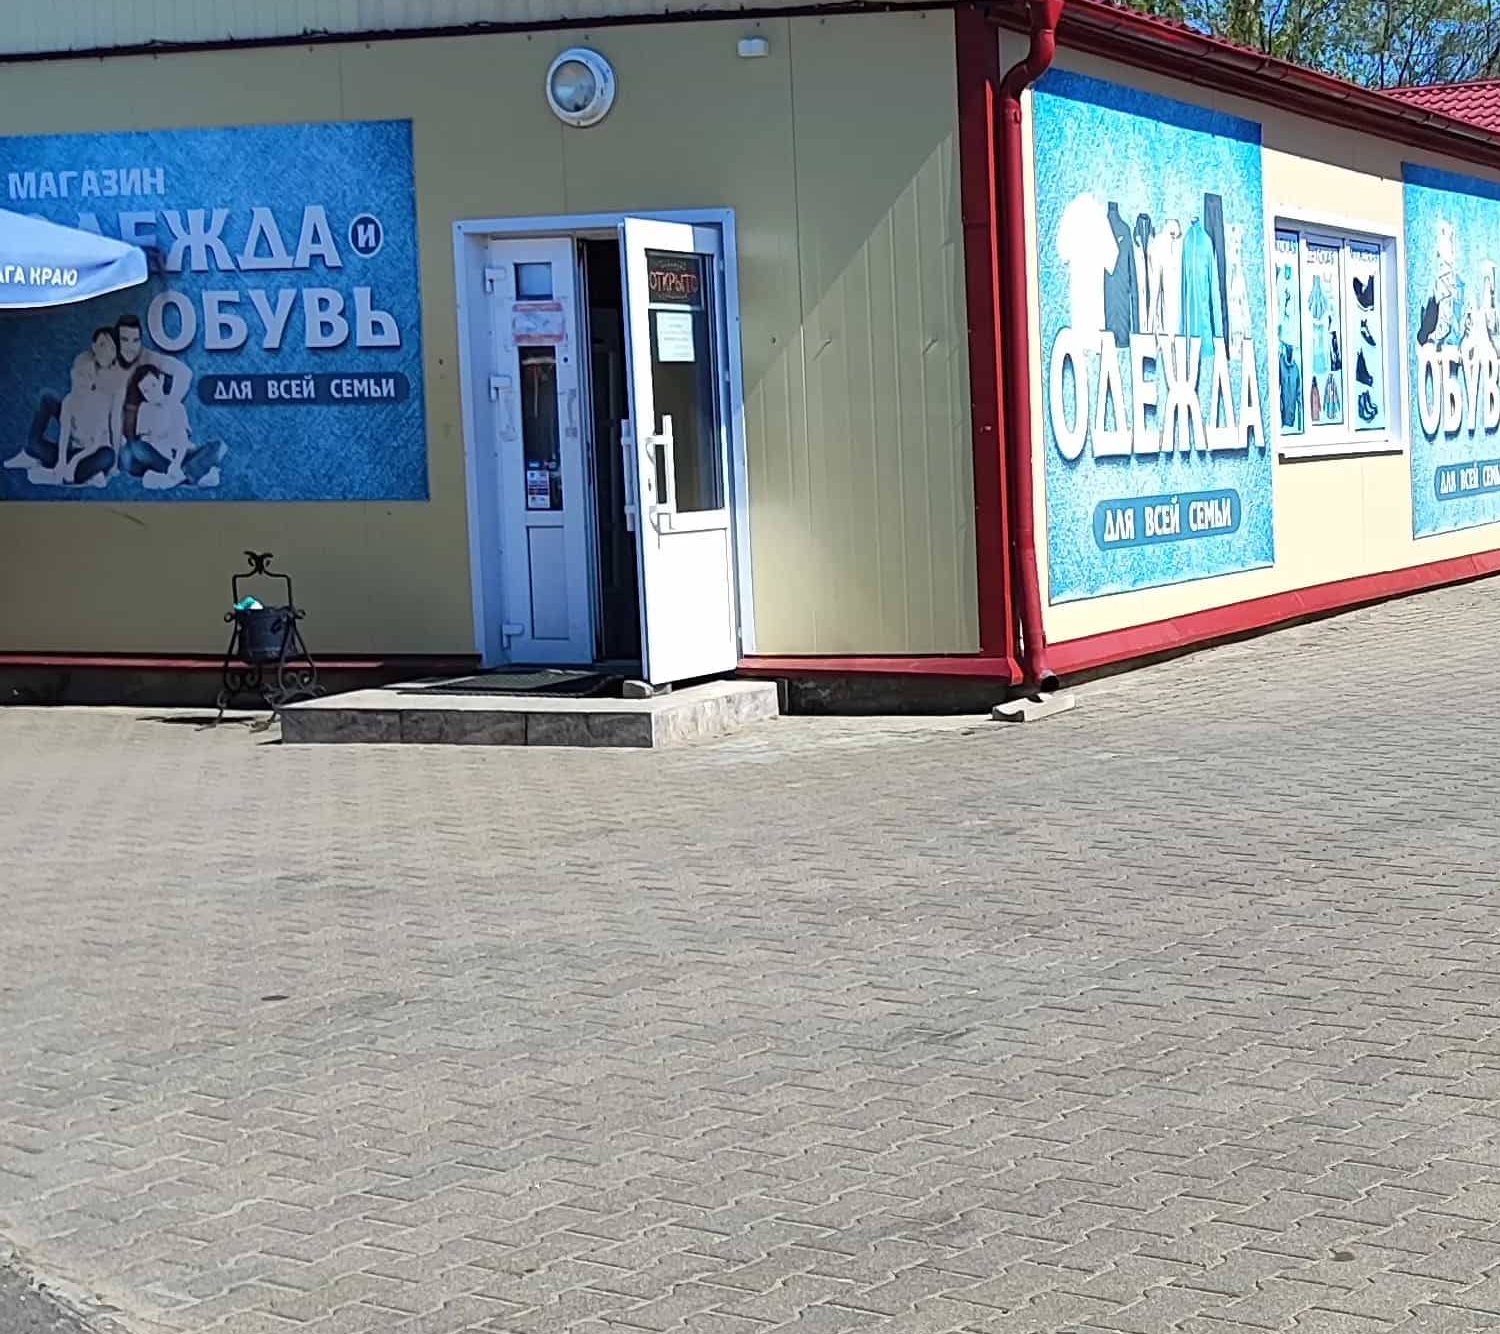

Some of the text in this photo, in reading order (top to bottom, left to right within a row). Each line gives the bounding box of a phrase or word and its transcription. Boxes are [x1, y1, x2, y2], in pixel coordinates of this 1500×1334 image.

[8, 168, 165, 199] МАГАЗИН
[30, 205, 342, 271] ЕЖДА
[29, 266, 79, 287] КРАЮ
[147, 286, 400, 351] ОБУВЬ
[213, 374, 395, 400] ДЛЯ ВСЕЙ СЕМЬИ
[1050, 326, 1266, 460] ОДЕЖДА
[1440, 470, 1457, 495] ДЛЯ
[1460, 461, 1480, 490] ВСЕЙ
[1103, 496, 1232, 542] ДЛЯ ВСЕЙ СЕМЬИ
